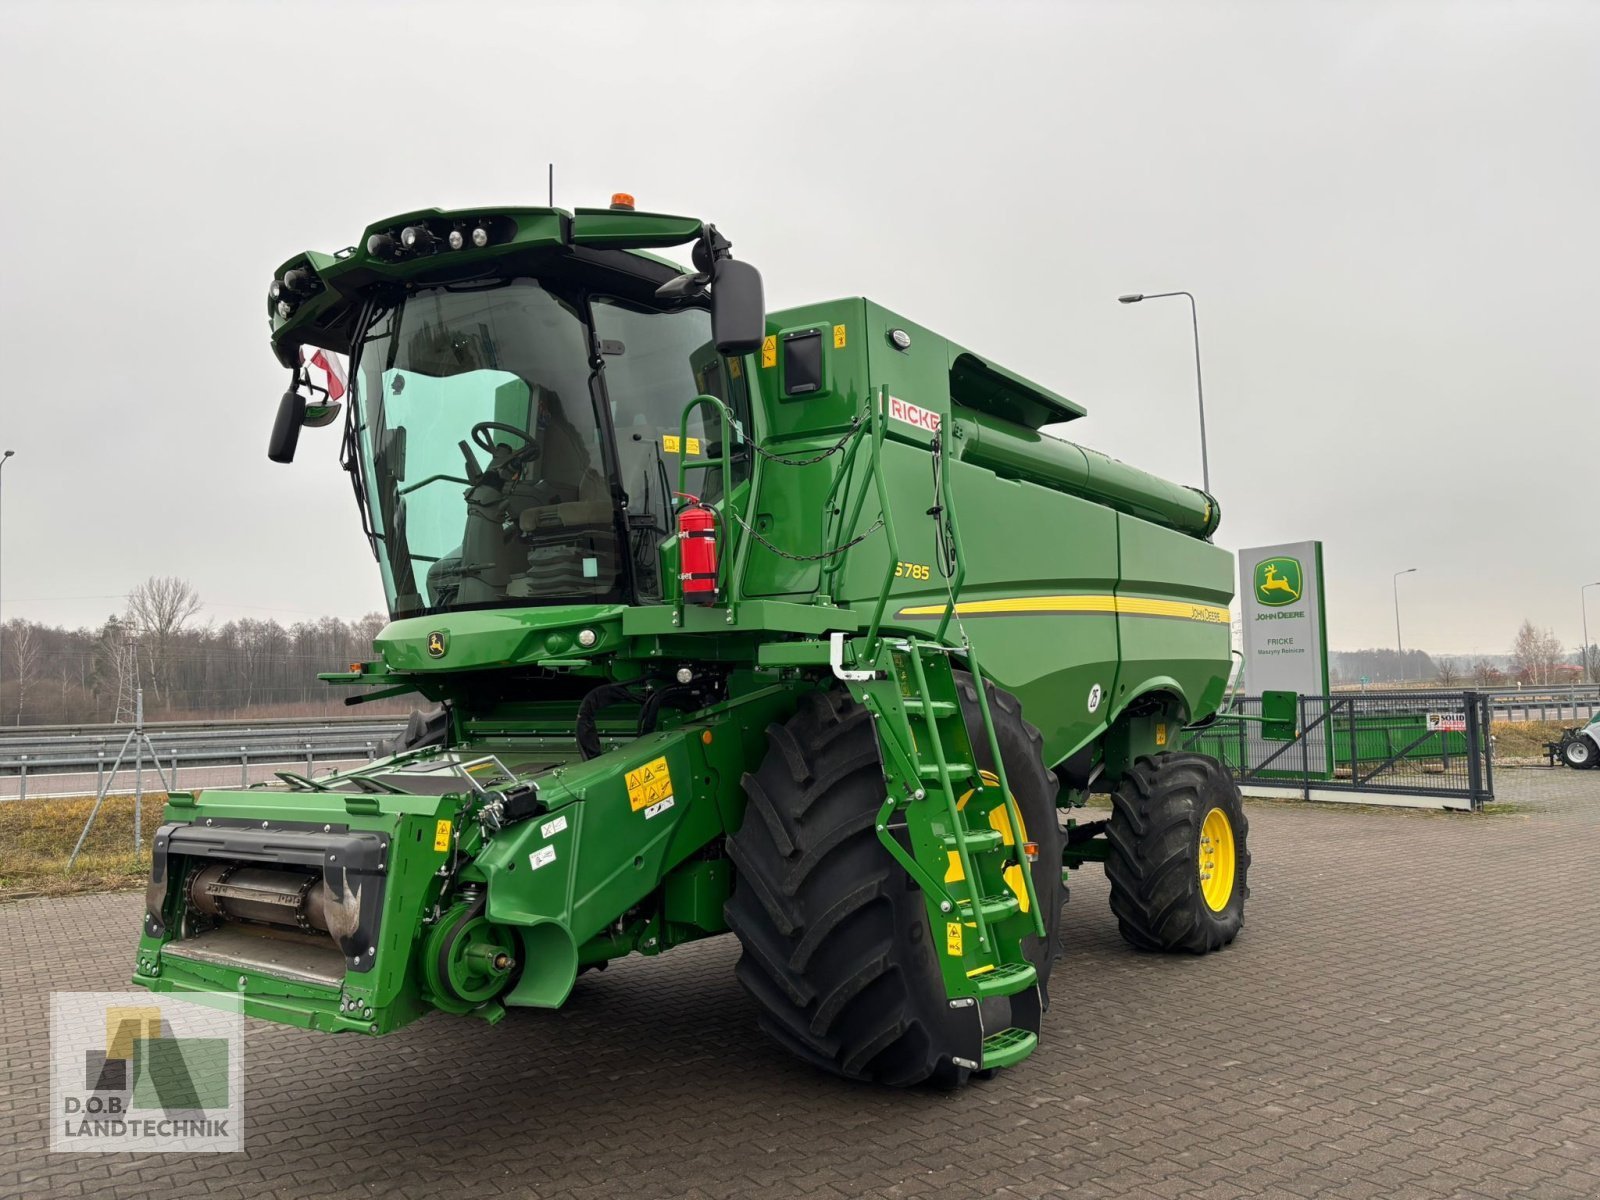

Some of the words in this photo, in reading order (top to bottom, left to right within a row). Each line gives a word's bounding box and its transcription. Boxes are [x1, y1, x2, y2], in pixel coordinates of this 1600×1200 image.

[881, 397, 940, 431] RICKE
[1255, 613, 1277, 621] JOHN
[1277, 611, 1305, 619] DEERE
[1267, 637, 1294, 646] FRICKE
